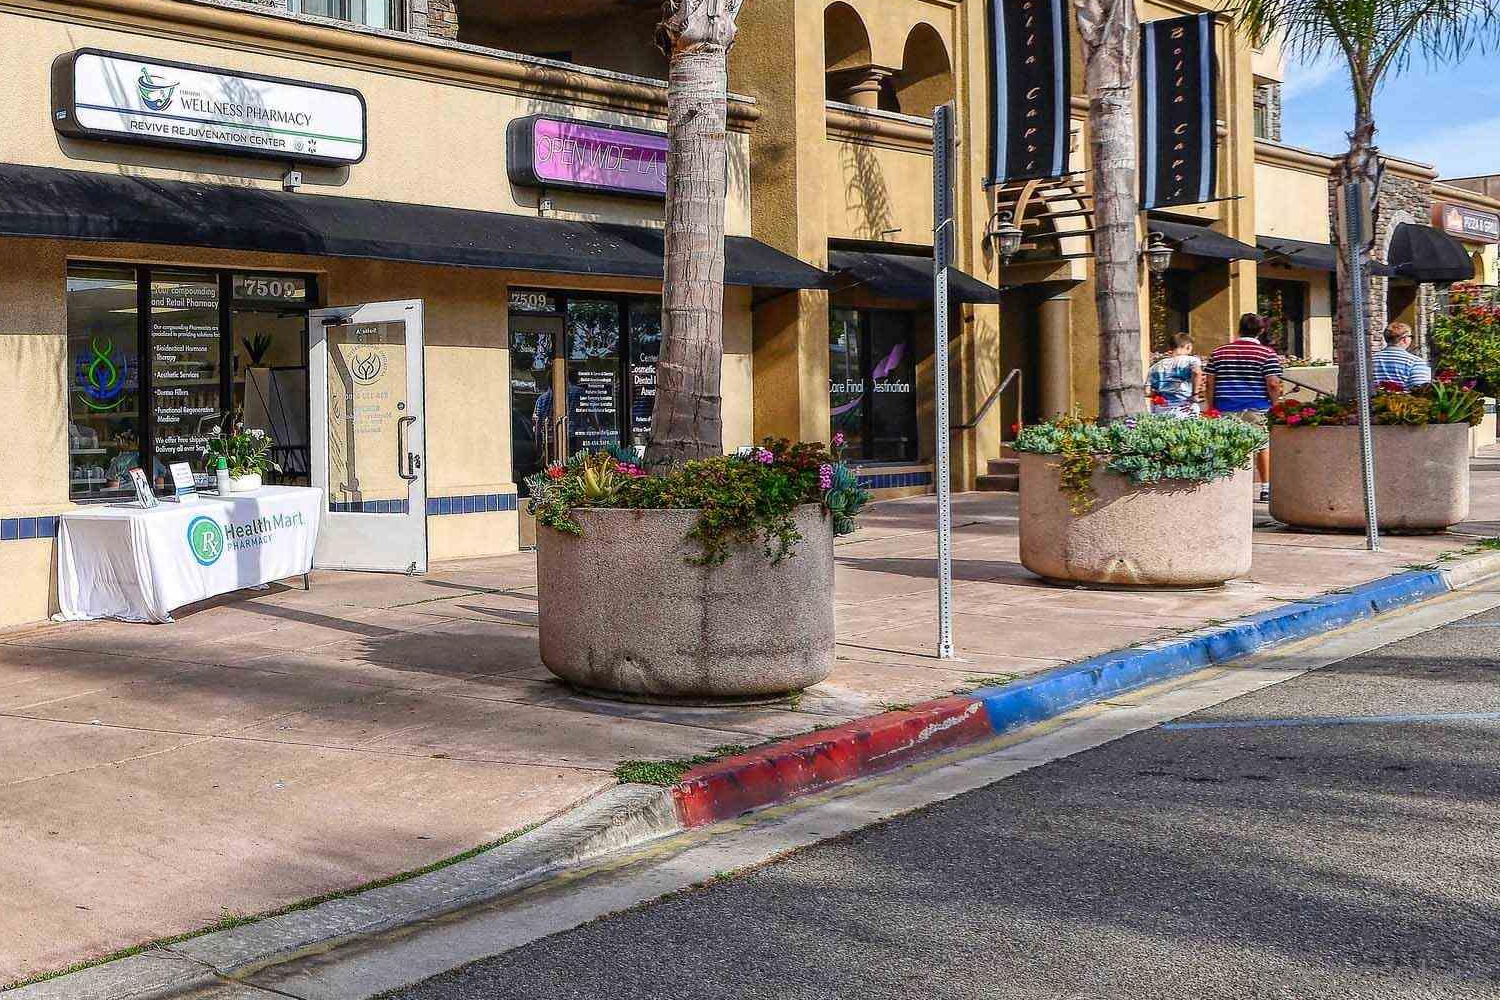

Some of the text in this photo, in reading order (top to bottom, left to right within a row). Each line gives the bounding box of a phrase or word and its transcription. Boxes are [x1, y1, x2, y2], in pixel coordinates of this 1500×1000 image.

[180, 97, 312, 127] WELLNESS PHARMACY
[130, 120, 286, 148] REVIVE REJUVENATION CENTER
[537, 135, 585, 168] OPEN
[590, 143, 629, 172] WIDE
[155, 283, 216, 298] Your compounding
[244, 279, 296, 298] 7509
[151, 297, 219, 311] and Retail Pharmacy
[156, 353, 177, 362] Therapy
[180, 371, 199, 379] Services
[846, 378, 864, 393] Final
[157, 406, 183, 414] Functional
[157, 415, 181, 423] Medicine
[155, 436, 164, 444] We
[164, 436, 177, 444] offer
[155, 445, 176, 454] Delivery
[176, 444, 184, 452] all
[224, 511, 304, 541] Health Mart
[227, 533, 273, 551] PHARMACY
